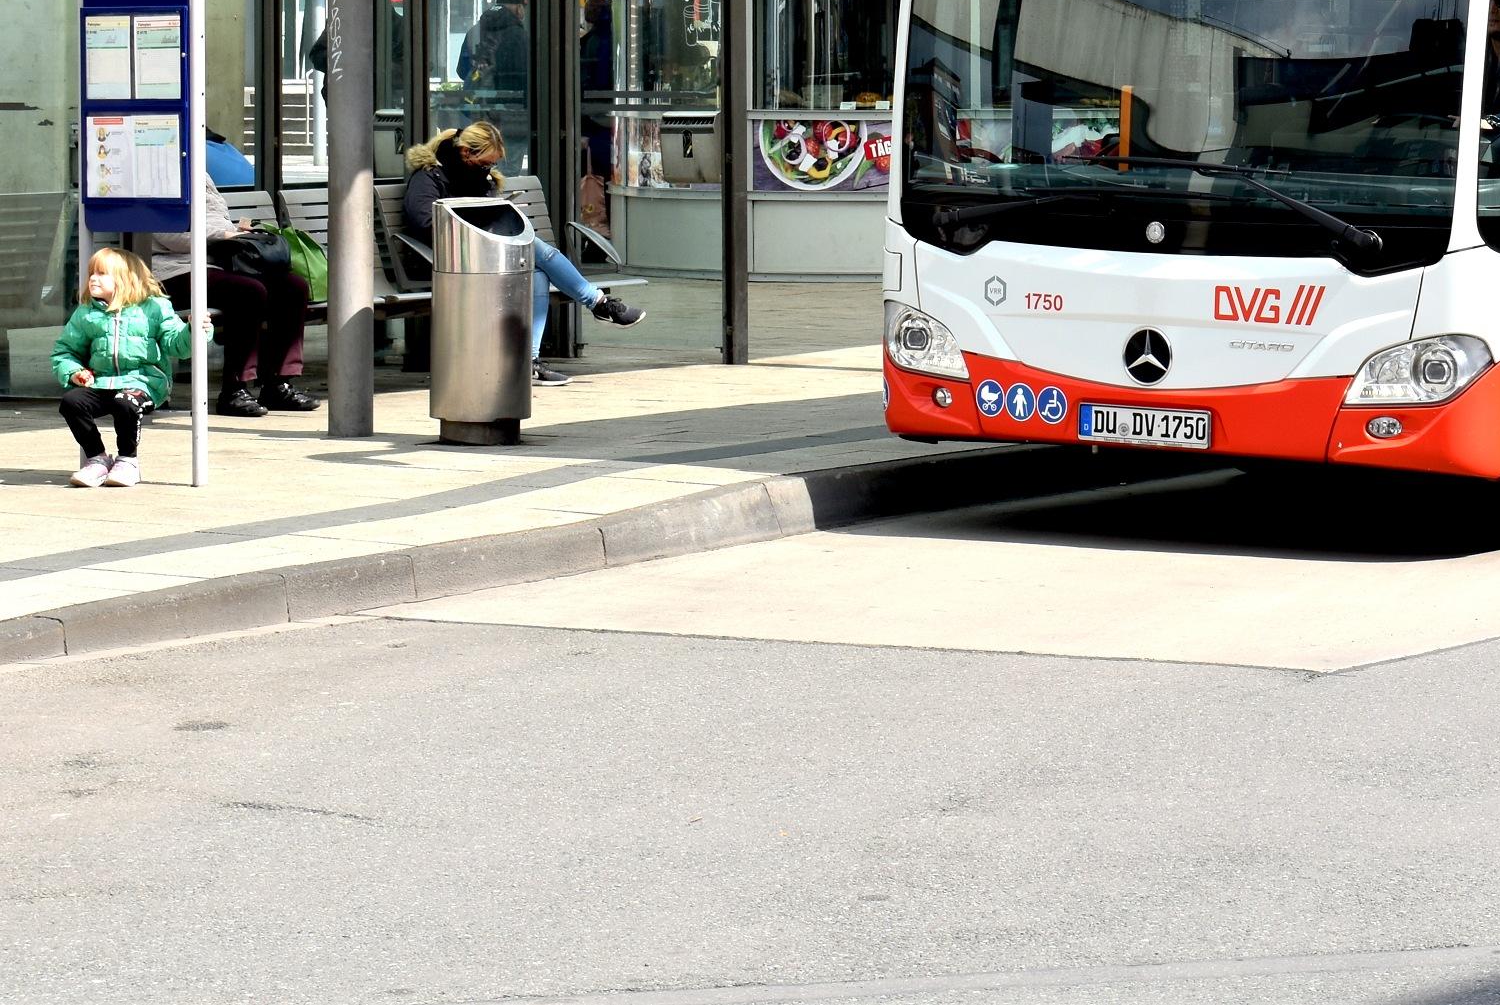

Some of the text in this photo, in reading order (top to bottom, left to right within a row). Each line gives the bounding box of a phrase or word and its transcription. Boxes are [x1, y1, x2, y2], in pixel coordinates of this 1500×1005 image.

[989, 287, 1003, 296] VRR
[1024, 292, 1063, 311] 1750
[1228, 340, 1295, 353] CITARO
[1093, 409, 1207, 440] DU DV 1750
